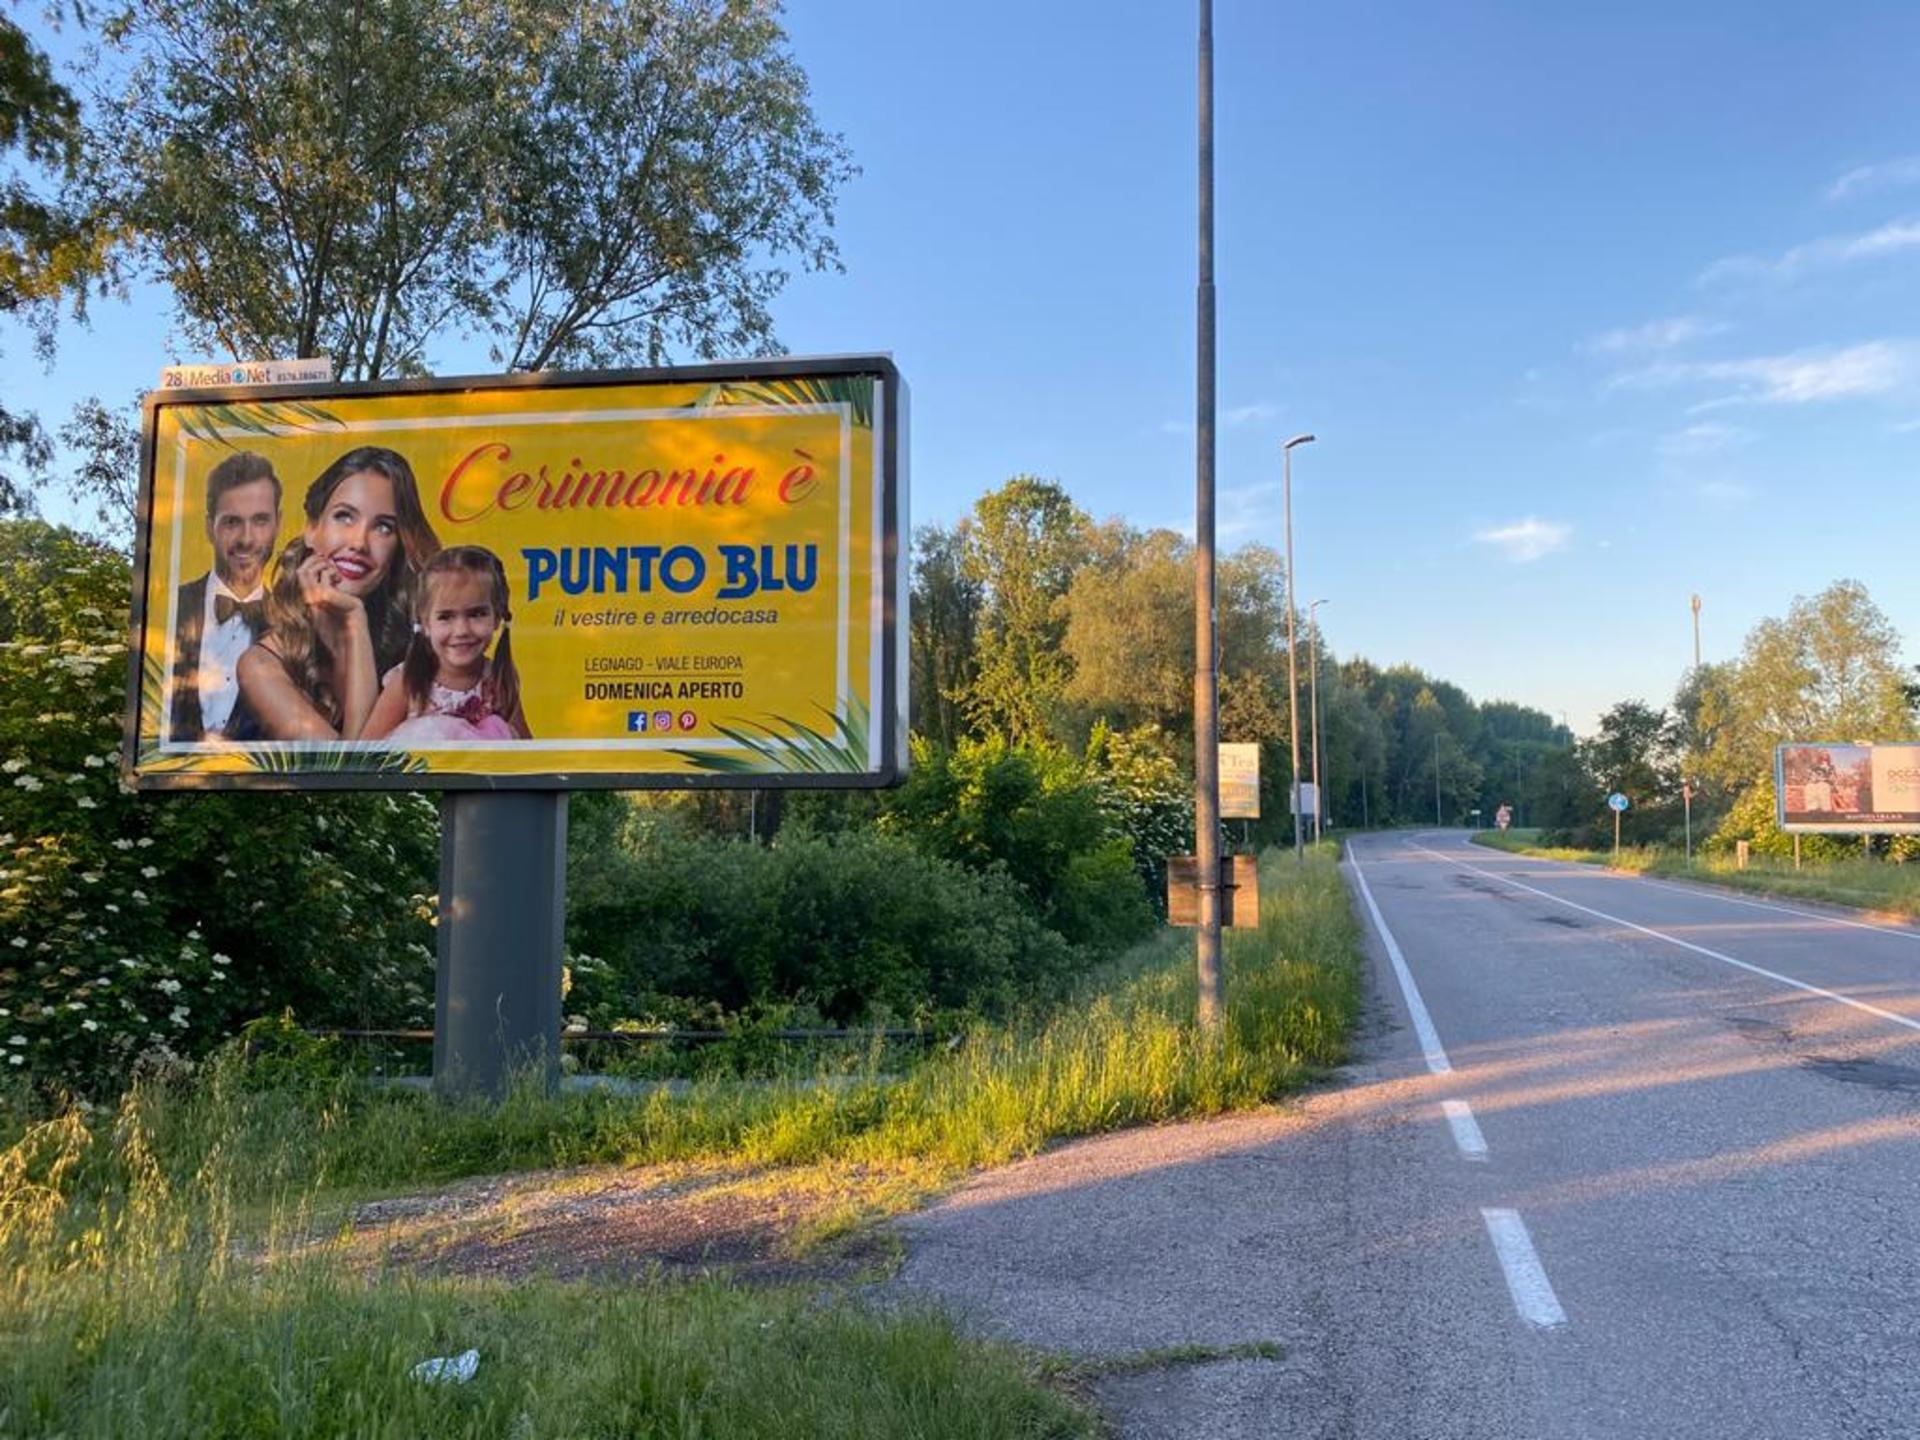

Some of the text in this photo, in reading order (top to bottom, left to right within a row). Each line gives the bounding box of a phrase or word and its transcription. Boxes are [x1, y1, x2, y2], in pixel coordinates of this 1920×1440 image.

[165, 372, 183, 387] 28
[190, 368, 231, 386] Media
[246, 366, 271, 384] Net
[440, 442, 820, 523] Cerimonia è
[521, 543, 818, 601] PUNTO BLU
[554, 607, 779, 627] il vestire e arredocasa
[584, 656, 643, 672] LEGNAGO
[656, 655, 689, 671] VIALE
[693, 655, 743, 670] EUROPA
[584, 681, 744, 700] DOMENICA APERTO
